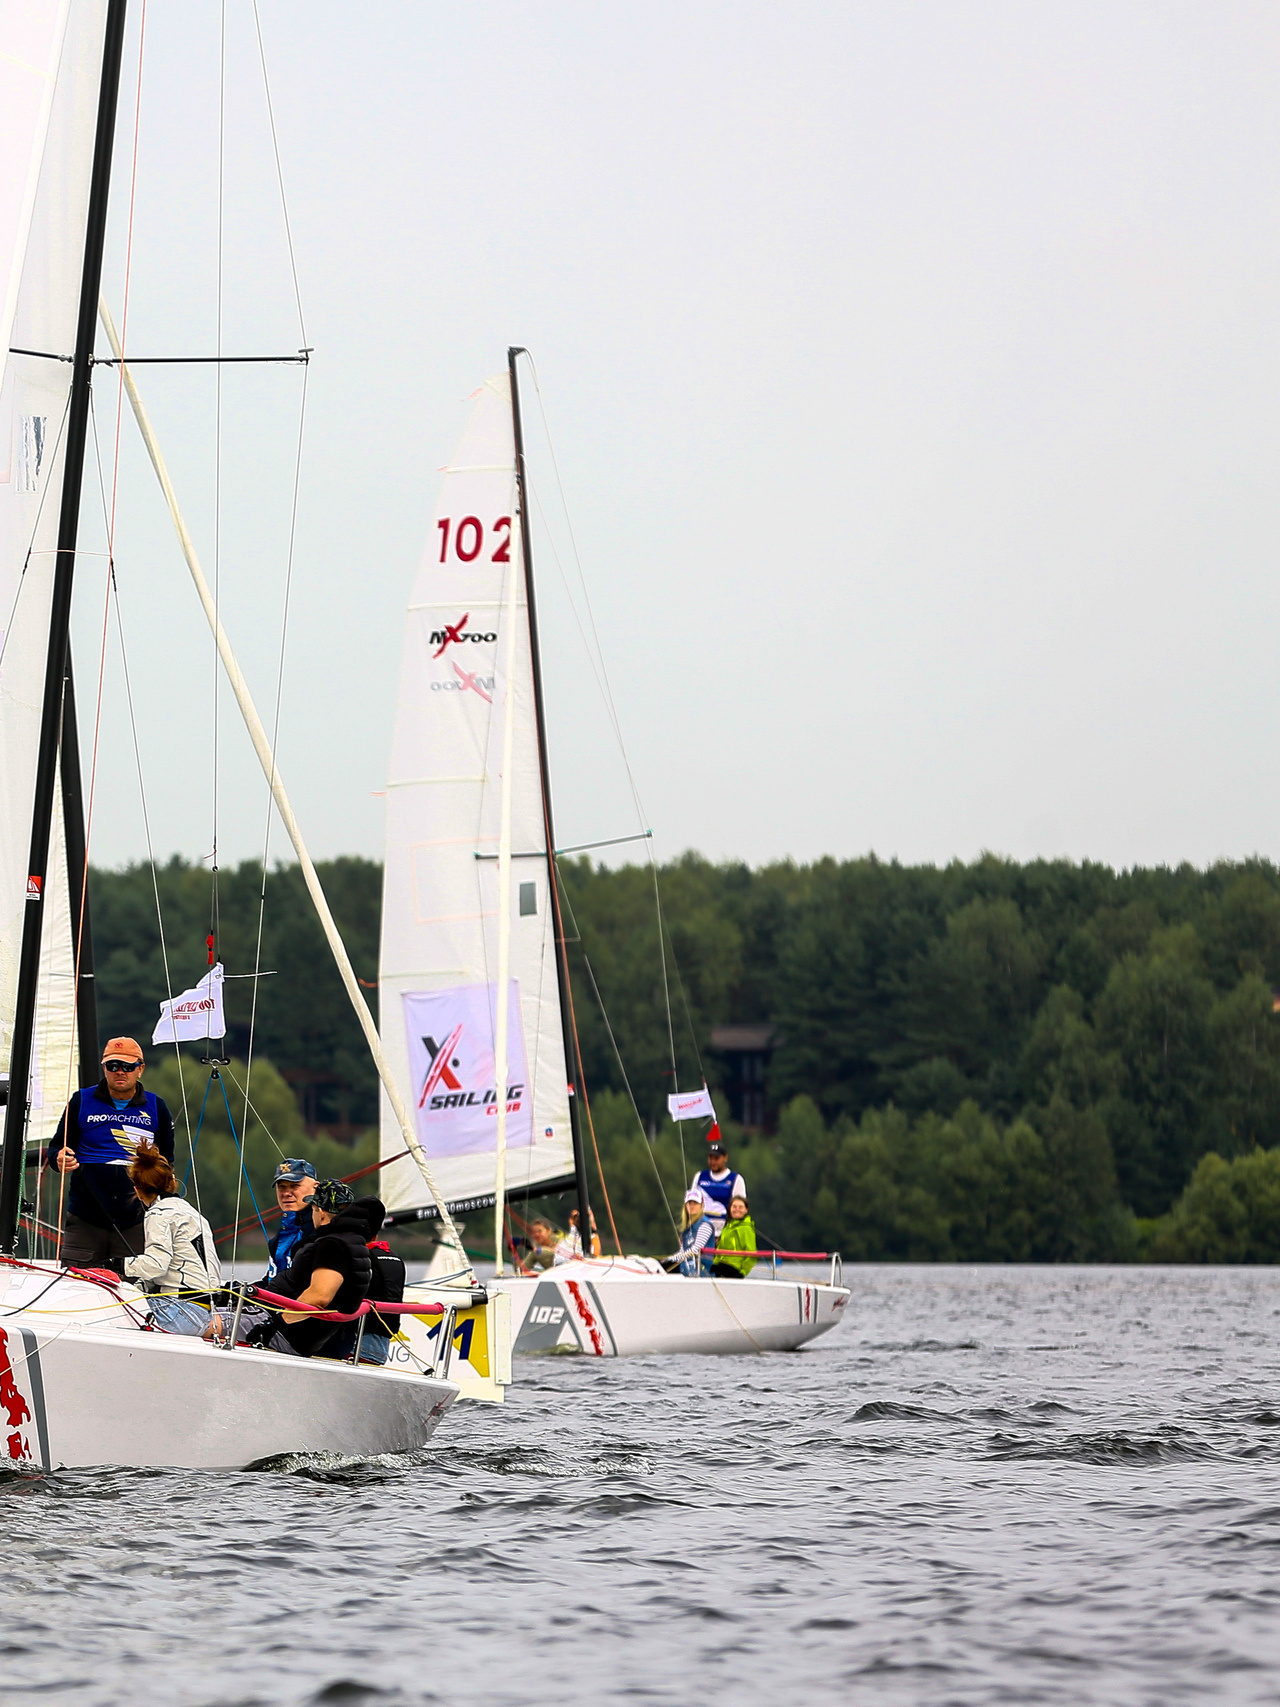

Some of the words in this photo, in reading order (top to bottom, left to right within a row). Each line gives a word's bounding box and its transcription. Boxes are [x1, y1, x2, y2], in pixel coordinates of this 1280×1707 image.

[437, 516, 512, 563] 102
[87, 1114, 151, 1125] PROYACHTING
[529, 1306, 564, 1324] 102
